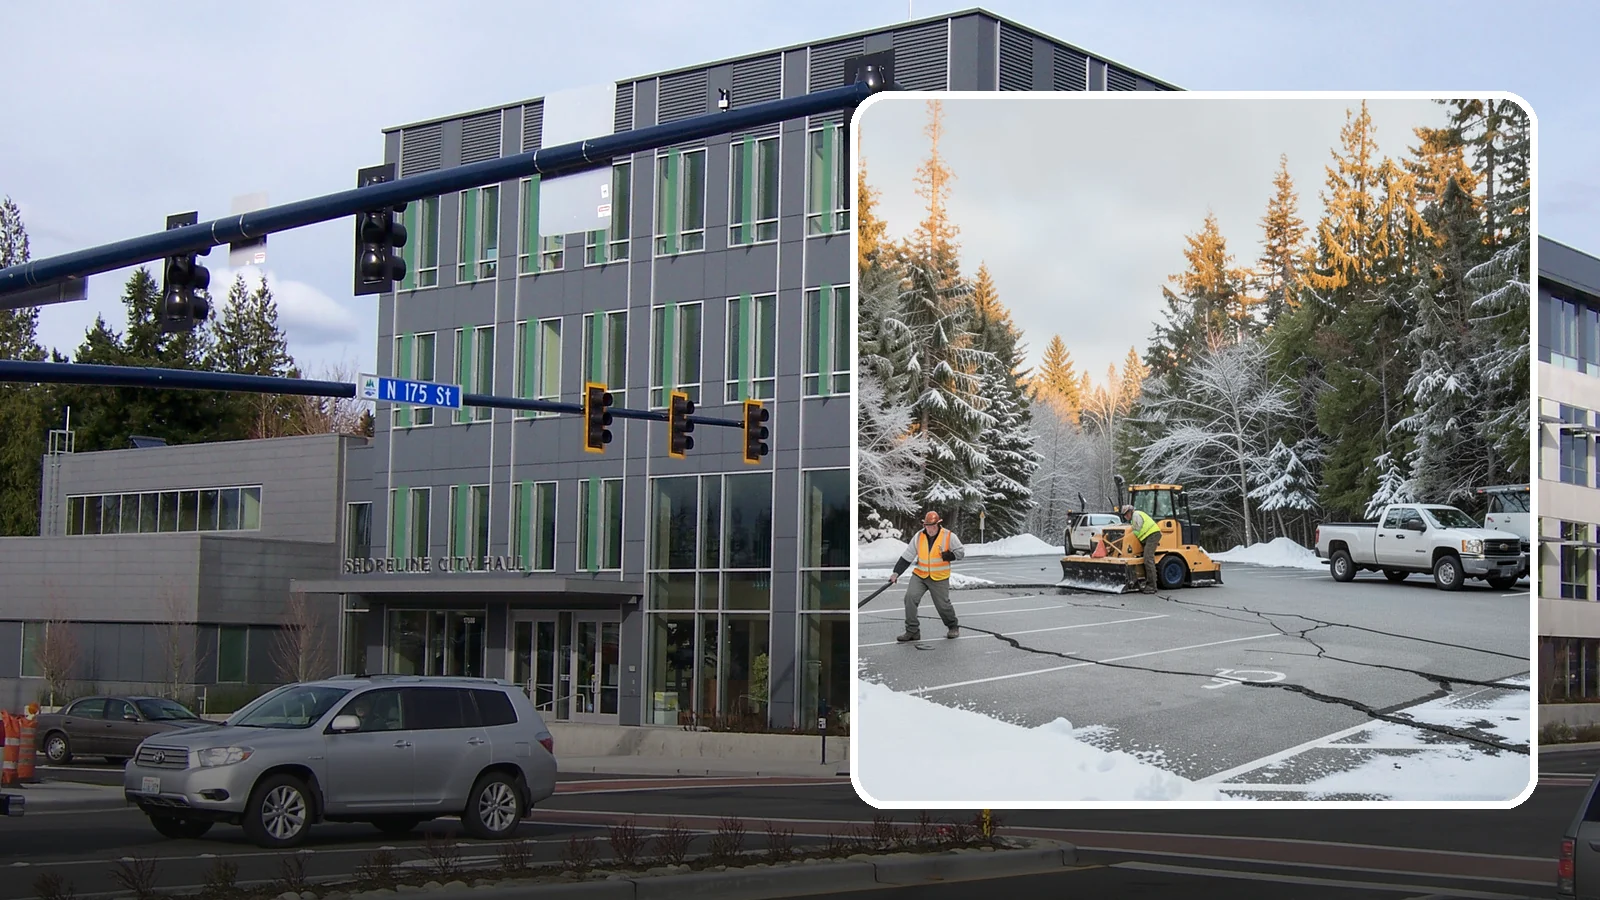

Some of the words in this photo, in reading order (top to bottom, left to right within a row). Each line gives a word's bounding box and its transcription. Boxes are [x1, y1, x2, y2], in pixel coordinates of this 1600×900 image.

[387, 380, 396, 400] N
[405, 382, 428, 403] 175
[436, 386, 452, 406] St
[343, 557, 431, 574] SHORELINE
[439, 556, 475, 573] CITY
[483, 555, 525, 572] HALL
